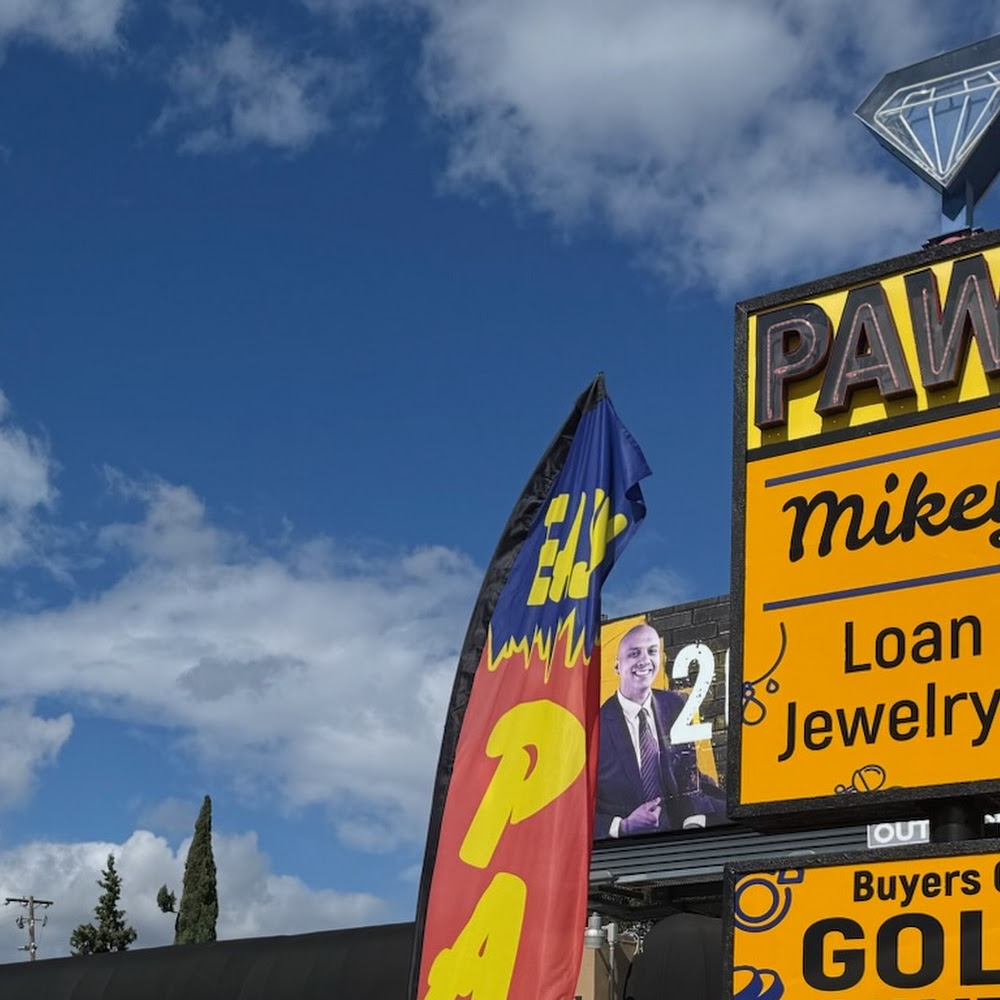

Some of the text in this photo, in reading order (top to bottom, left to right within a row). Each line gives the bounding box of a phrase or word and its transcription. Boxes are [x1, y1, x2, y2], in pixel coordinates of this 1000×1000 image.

[755, 254, 1000, 431] PAW
[782, 472, 1000, 562] Mike
[844, 614, 982, 674] Loan
[778, 682, 1000, 762] Jewelry
[873, 819, 929, 844] OUT
[853, 869, 981, 907] Buyers
[802, 910, 1000, 991] GOL
